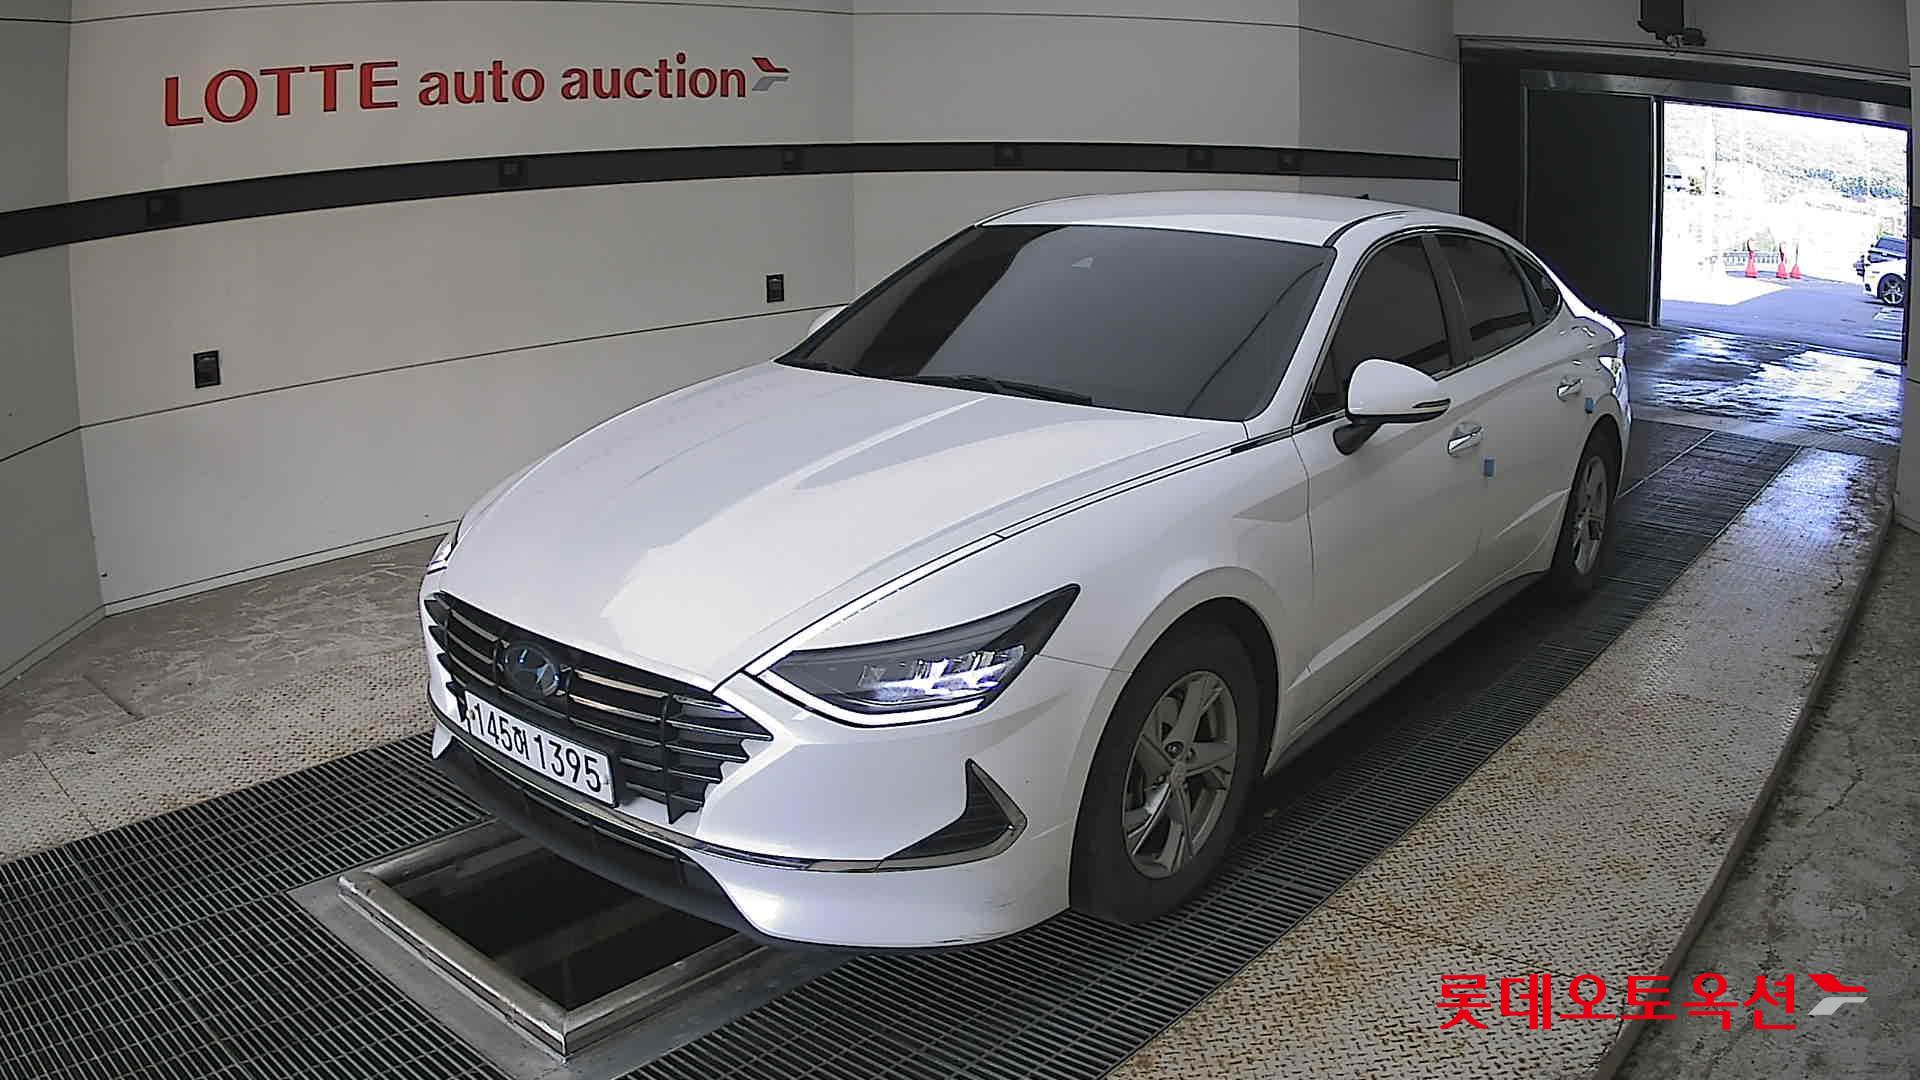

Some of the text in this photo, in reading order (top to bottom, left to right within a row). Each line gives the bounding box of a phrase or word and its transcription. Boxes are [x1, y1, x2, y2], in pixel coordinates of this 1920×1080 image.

[163, 53, 747, 126] LOTTE auto auction
